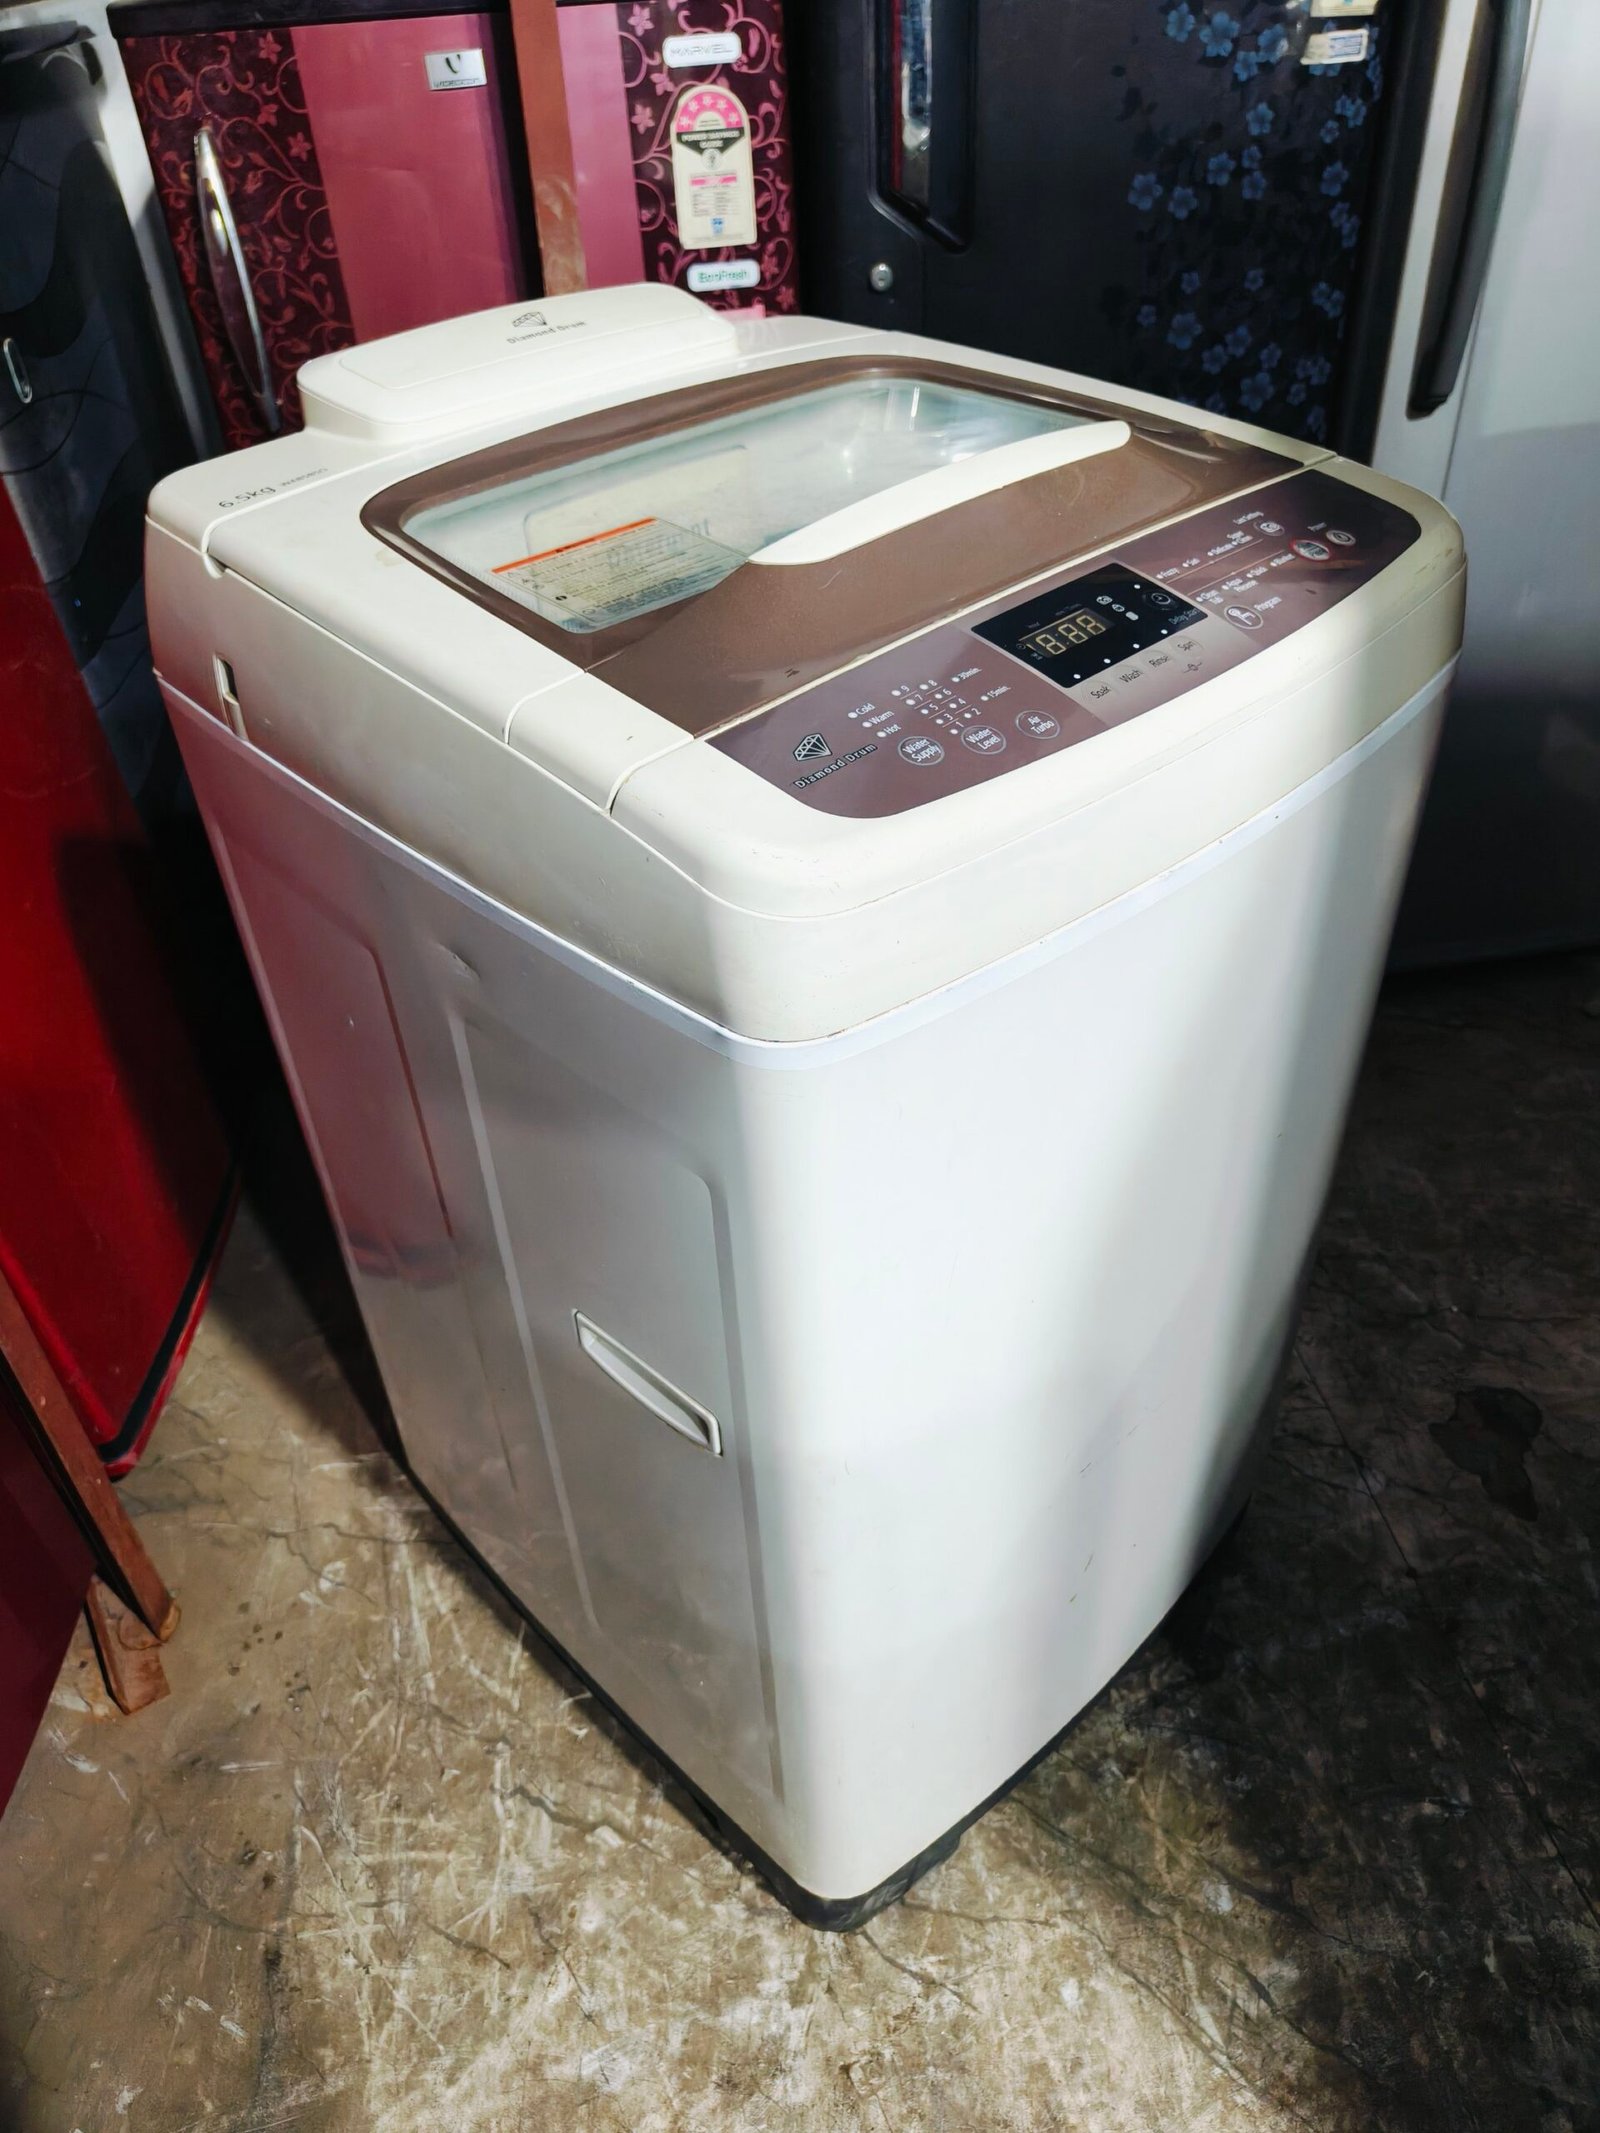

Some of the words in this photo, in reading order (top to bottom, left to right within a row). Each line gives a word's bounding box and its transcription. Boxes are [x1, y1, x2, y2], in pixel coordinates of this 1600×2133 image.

[506, 327, 556, 344] Diamond
[556, 321, 586, 331] Drum
[219, 486, 276, 508] 6.5kg
[1254, 596, 1282, 611] Program
[1090, 684, 1111, 700] Soak
[1119, 669, 1144, 684] Wash
[1149, 653, 1171, 668] Rinse
[900, 685, 910, 693] 9
[928, 679, 938, 687] 8
[942, 688, 952, 696] 6
[856, 703, 876, 715] Cold
[929, 702, 939, 711] 5
[943, 713, 953, 721] 3
[971, 707, 982, 716] 2
[869, 710, 895, 725] Warm
[1027, 715, 1041, 726] Air
[884, 724, 902, 735] Hot
[1030, 719, 1055, 735] Turbo
[966, 727, 992, 744] Water
[977, 735, 1001, 750] Level
[902, 739, 930, 755] Water
[912, 744, 942, 763] Supply
[794, 758, 847, 789] Diamond
[844, 743, 878, 763] Drum
